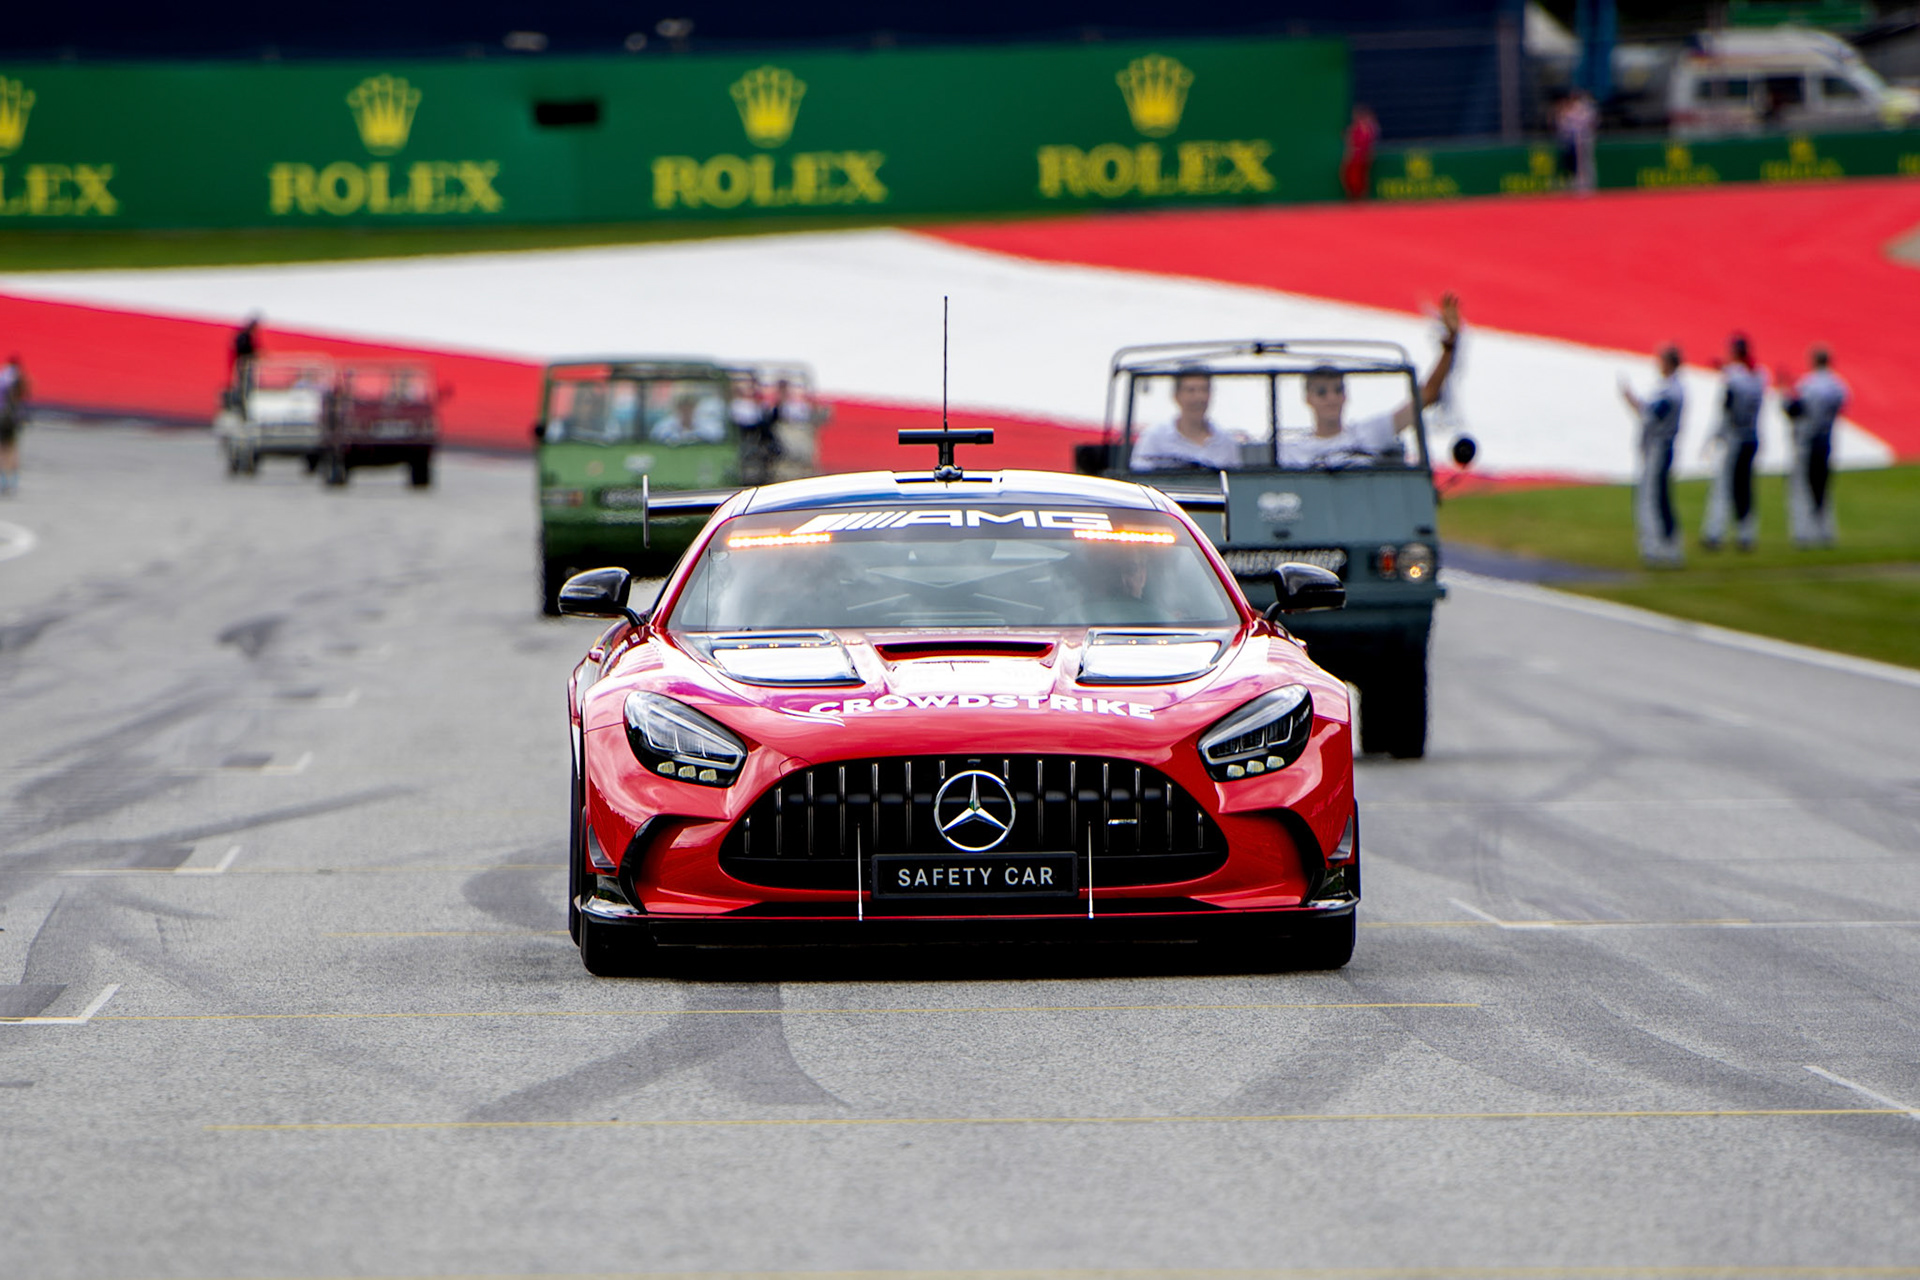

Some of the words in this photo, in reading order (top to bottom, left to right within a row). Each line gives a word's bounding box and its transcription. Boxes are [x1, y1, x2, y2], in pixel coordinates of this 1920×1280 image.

[269, 160, 503, 216] ROLEX
[651, 150, 887, 208] ROLEX
[1037, 140, 1276, 198] ROLEX
[888, 509, 1114, 531] AMG
[808, 694, 1155, 720] CROWDSTRIKE
[897, 867, 992, 887] SAFETY
[1003, 866, 1054, 886] CAR
